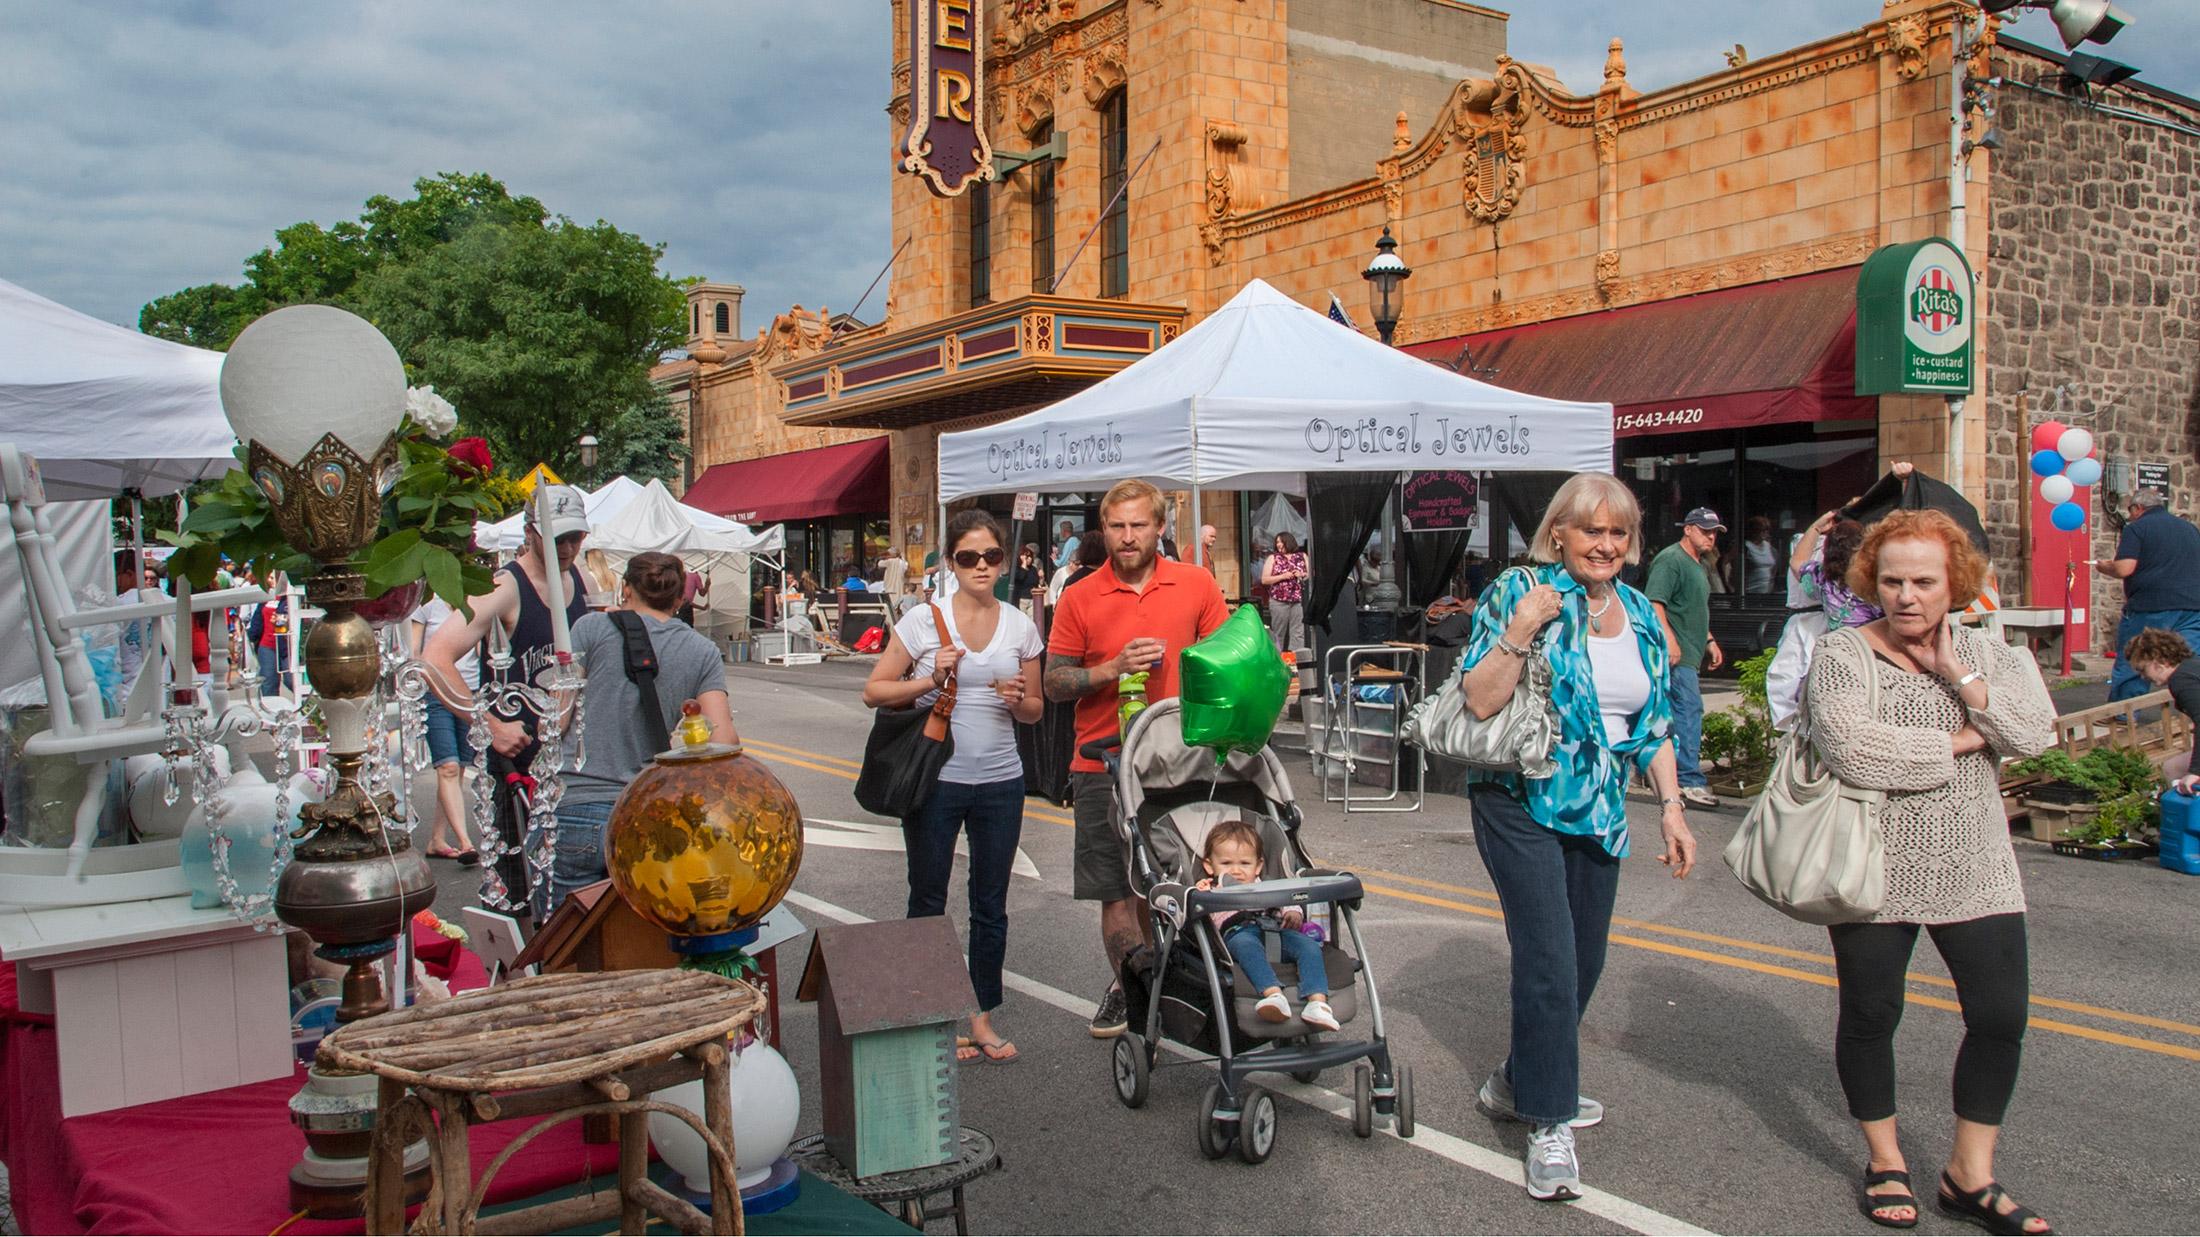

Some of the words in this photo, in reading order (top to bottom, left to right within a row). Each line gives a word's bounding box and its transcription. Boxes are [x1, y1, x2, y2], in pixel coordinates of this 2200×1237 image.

[1918, 286, 1958, 315] Rita's
[1912, 354, 1926, 366] ice
[1930, 356, 1963, 368] custard
[1915, 368, 1960, 384] happiness
[1615, 408, 1703, 430] 15-643-4420
[1305, 412, 1421, 463] Optical
[1432, 415, 1530, 456] Jewels
[987, 429, 1049, 480] Optical
[1055, 421, 1122, 469] Jewels
[1404, 471, 1440, 499] OPTICAL
[1444, 470, 1476, 495] JEWELS
[1418, 496, 1462, 507] Handcrafted
[1440, 507, 1446, 517] &
[520, 643, 554, 684] VIRGI
